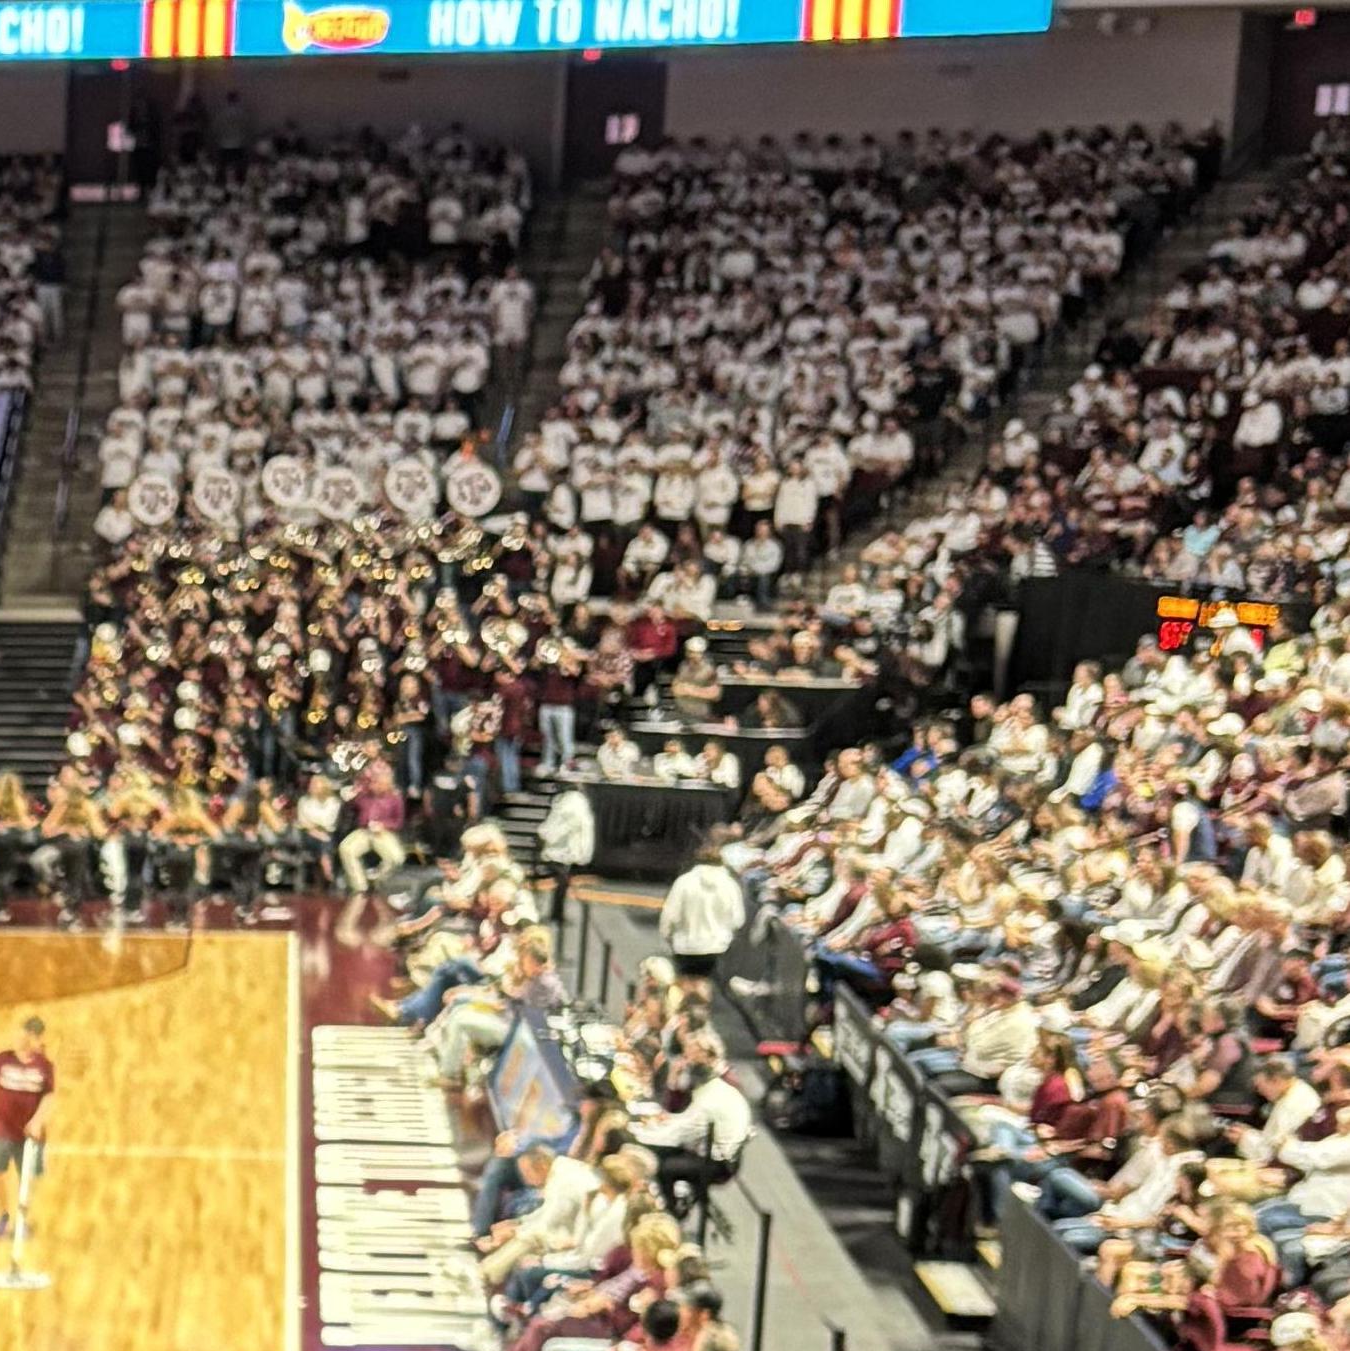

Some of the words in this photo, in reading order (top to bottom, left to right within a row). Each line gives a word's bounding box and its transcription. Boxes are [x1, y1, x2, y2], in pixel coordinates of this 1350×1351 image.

[429, 0, 520, 46] HOW
[536, 0, 582, 43] TO
[595, 0, 739, 41] NACHO!
